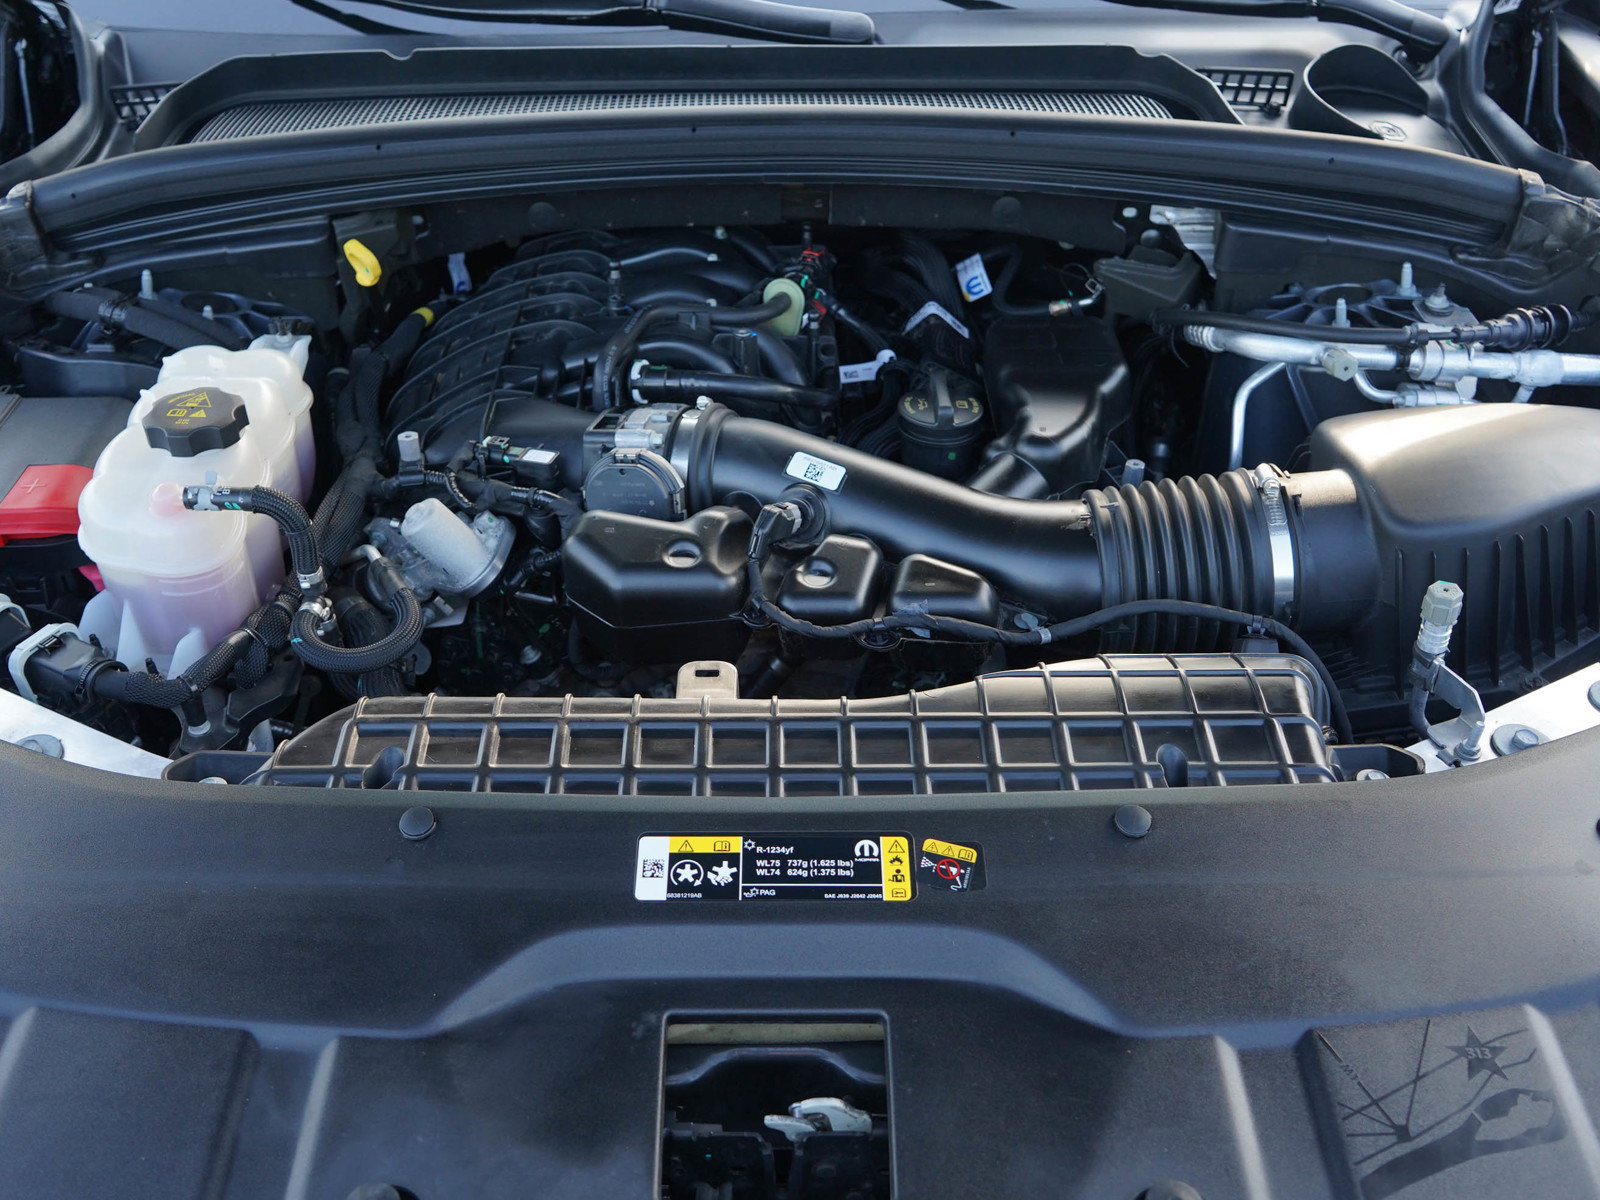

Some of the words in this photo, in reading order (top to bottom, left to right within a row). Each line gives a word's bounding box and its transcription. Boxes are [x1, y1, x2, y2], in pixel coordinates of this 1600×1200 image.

[756, 846, 794, 855] R-1234yf
[756, 859, 781, 867] WL75
[787, 859, 808, 868] 737g
[809, 859, 836, 868] (1.625
[837, 859, 854, 868] lbs)
[756, 868, 781, 876] WL74
[787, 868, 808, 877] 624g
[809, 868, 836, 877] (1.375
[837, 868, 854, 877] lbs)
[1465, 1047, 1492, 1060] 313
